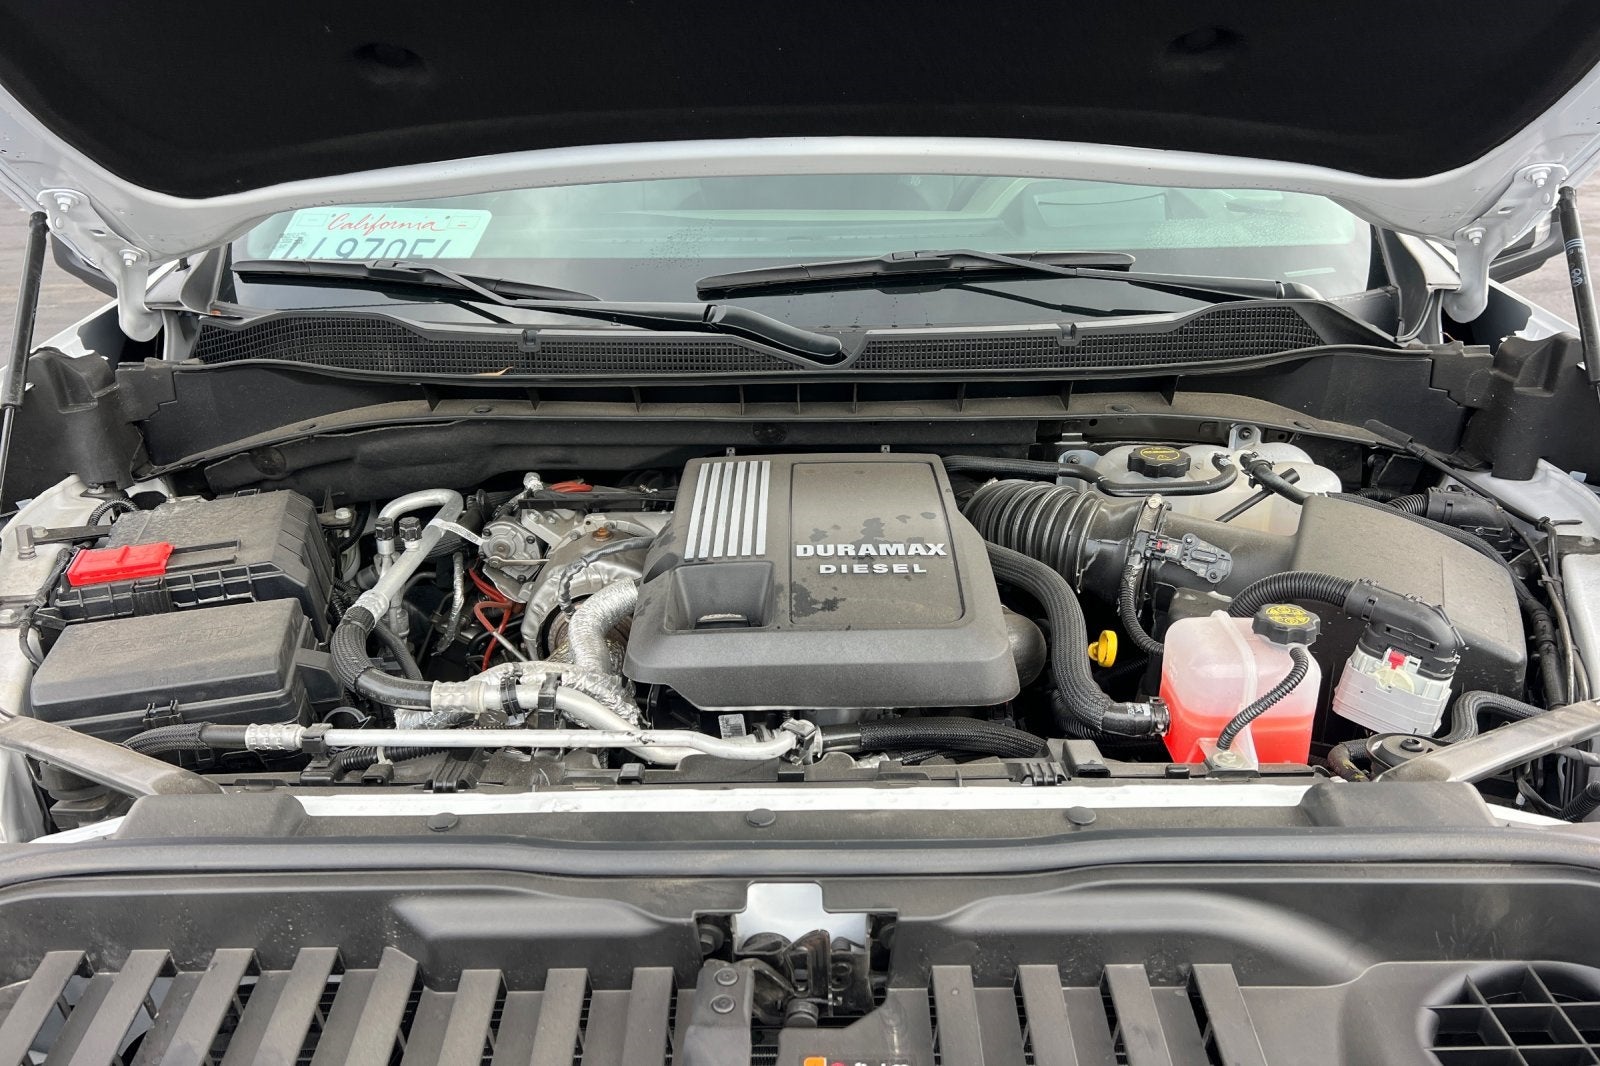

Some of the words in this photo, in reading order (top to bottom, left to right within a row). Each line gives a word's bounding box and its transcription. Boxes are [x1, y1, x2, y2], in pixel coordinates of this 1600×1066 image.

[327, 212, 447, 236] California
[795, 542, 948, 558] DURAMAX
[819, 563, 927, 574] DIESEL
